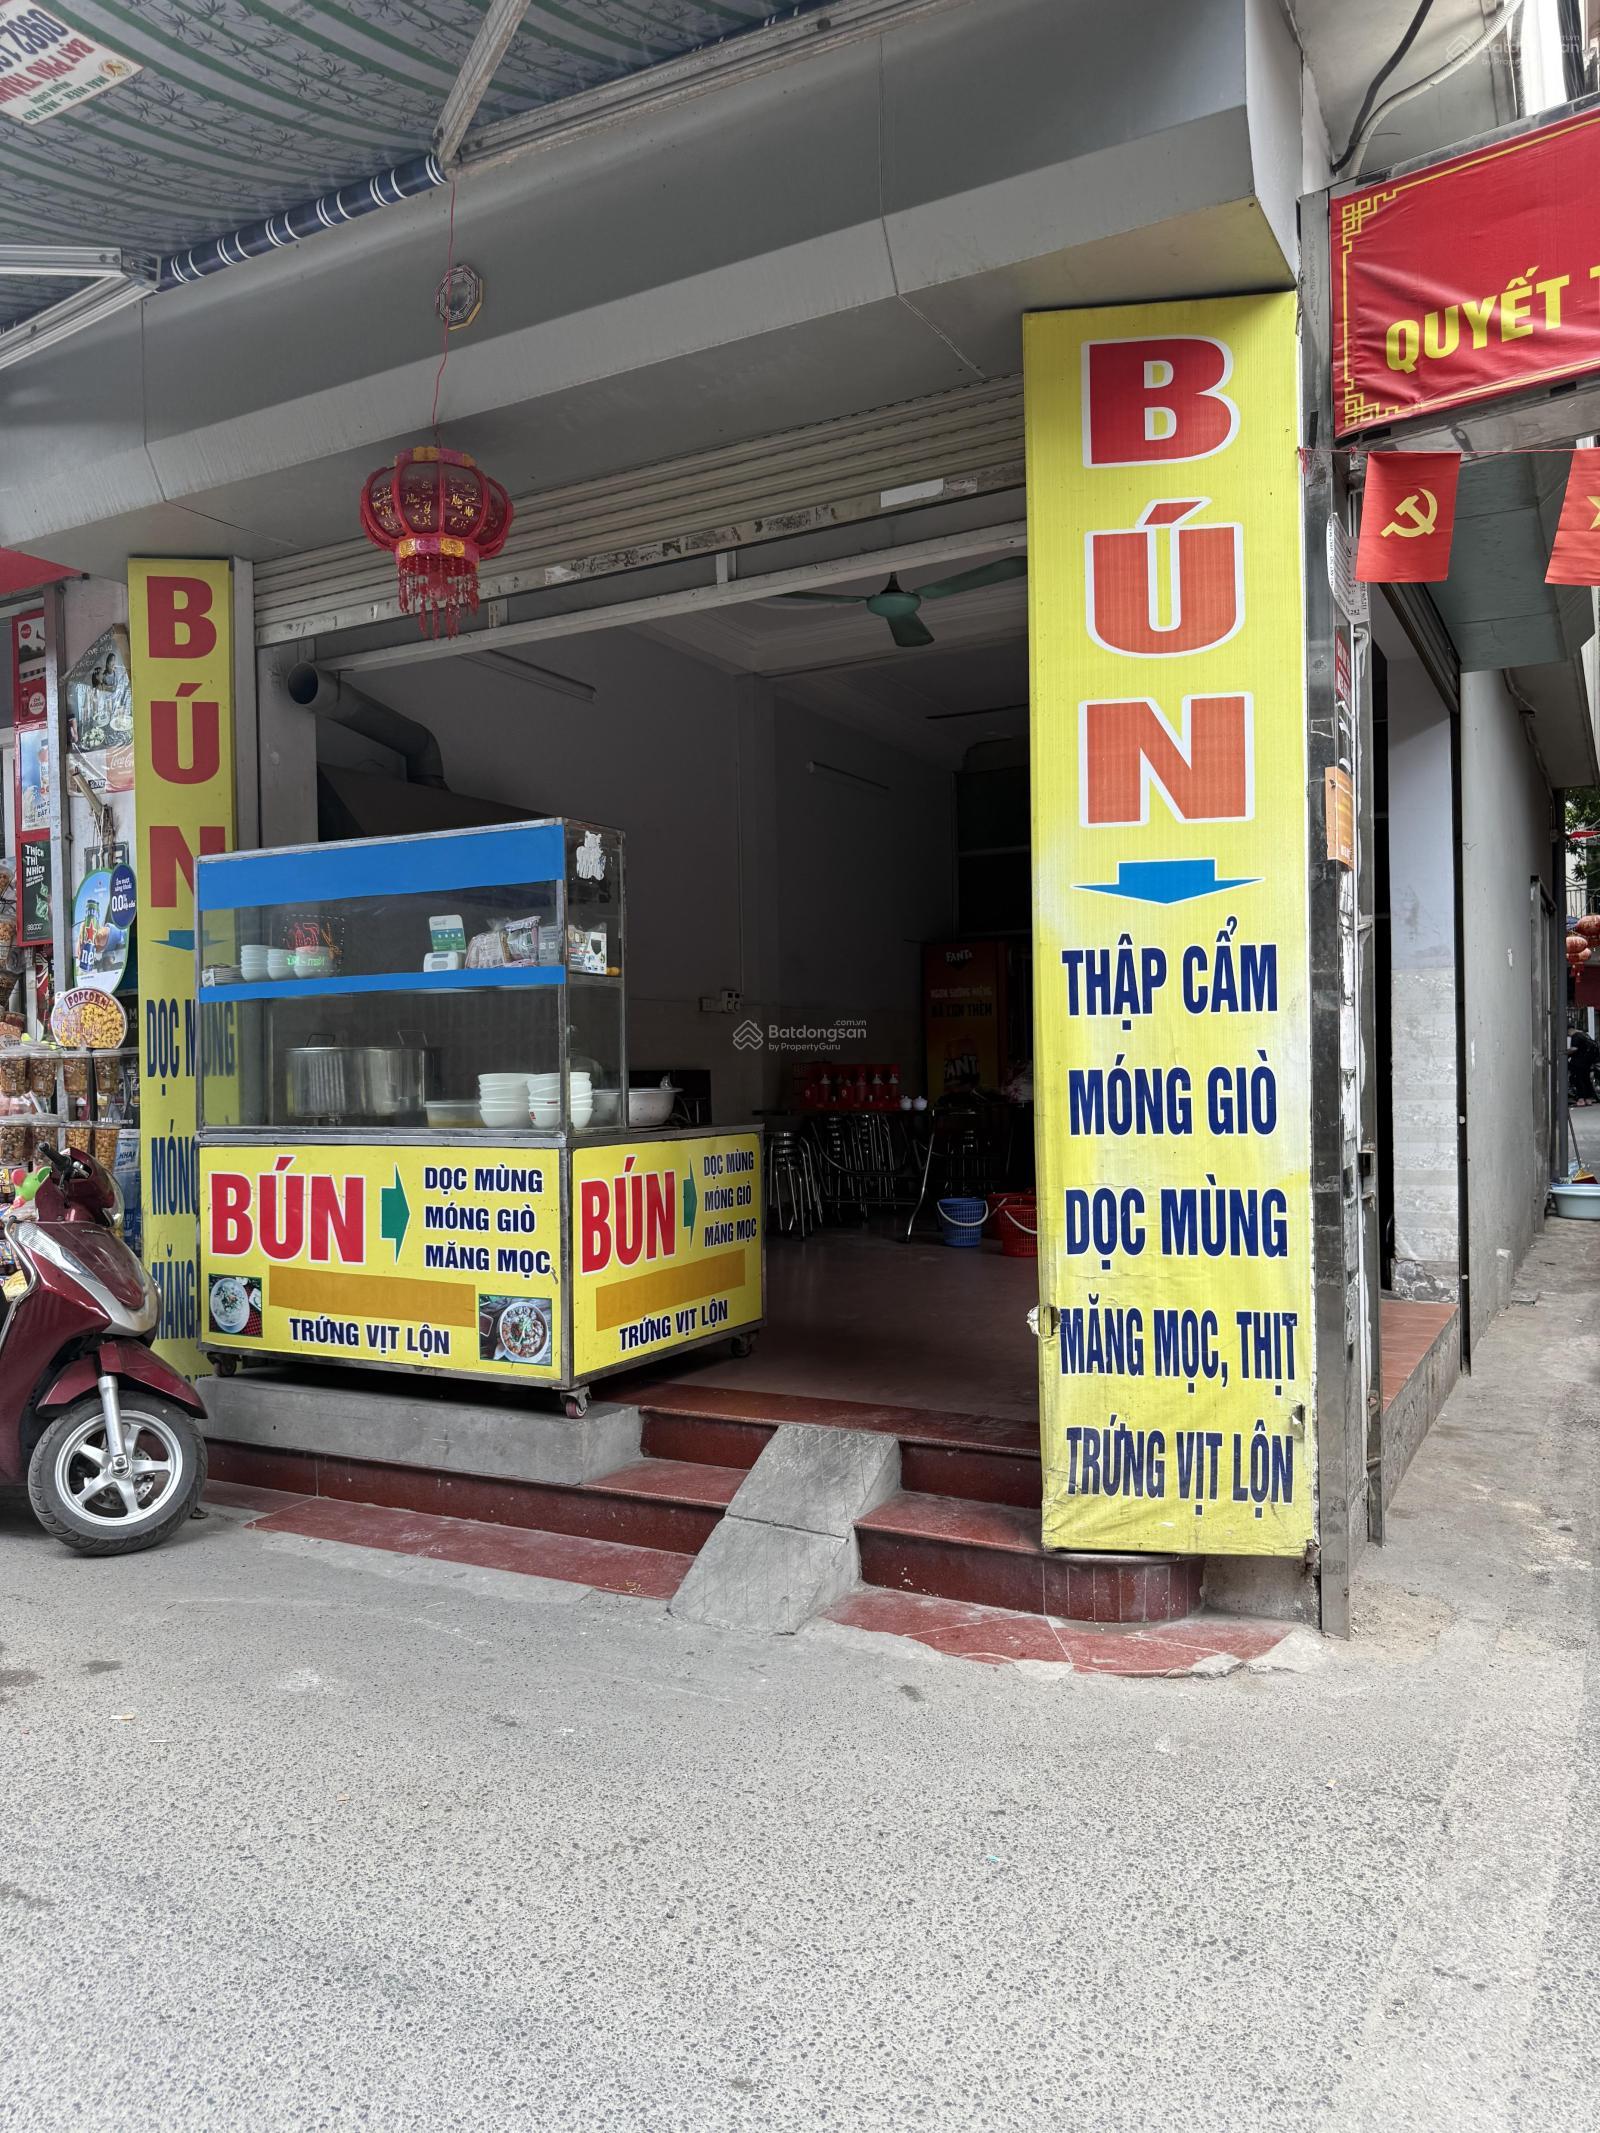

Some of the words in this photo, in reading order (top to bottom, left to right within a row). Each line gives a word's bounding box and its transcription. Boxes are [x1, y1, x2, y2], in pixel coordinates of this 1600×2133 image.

[1385, 265, 1570, 374] QUYẾT
[1081, 336, 1252, 826] BÚN
[146, 574, 225, 908] BÚN
[25, 855, 38, 866] THÌ
[68, 990, 109, 1007] POPCORN
[1061, 932, 1168, 1032] THẬP
[1181, 914, 1279, 1015] CẨM
[146, 997, 181, 1097] DỌC
[1067, 1052, 1193, 1137] MÓNG
[1206, 1048, 1277, 1136] GIÒ
[424, 1166, 468, 1194] DỌC
[474, 1164, 543, 1193] MÙNG
[703, 1153, 724, 1180] DỌC
[725, 1148, 755, 1174] MÙNG
[704, 1184, 734, 1212] MÓNG
[736, 1180, 752, 1206] GIÒ
[209, 1156, 366, 1264] BÚN
[424, 1202, 490, 1231] MÓNG
[496, 1204, 537, 1233] GIÒ
[580, 1155, 676, 1274] BÚN
[704, 1220, 734, 1248] MĂNG
[736, 1216, 758, 1244] MỌC
[1064, 1186, 1147, 1271] DỌC
[1159, 1172, 1289, 1259] MÙNG
[424, 1241, 490, 1271] MĂNG
[496, 1248, 552, 1279] MỌC
[289, 1315, 360, 1346] TRỨNG
[366, 1324, 401, 1354] VỊT
[406, 1326, 451, 1360] LỘN
[619, 1314, 672, 1351] TRỨNG
[674, 1307, 698, 1337] VỊT
[701, 1298, 729, 1328] LỘN
[1059, 1292, 1144, 1377] MĂNG
[1152, 1308, 1229, 1395] MỌC,
[1235, 1310, 1298, 1397] THỊT
[1065, 1413, 1166, 1499] TRỨNG
[1175, 1430, 1223, 1516] VỊT
[1231, 1418, 1294, 1519] LỘN
